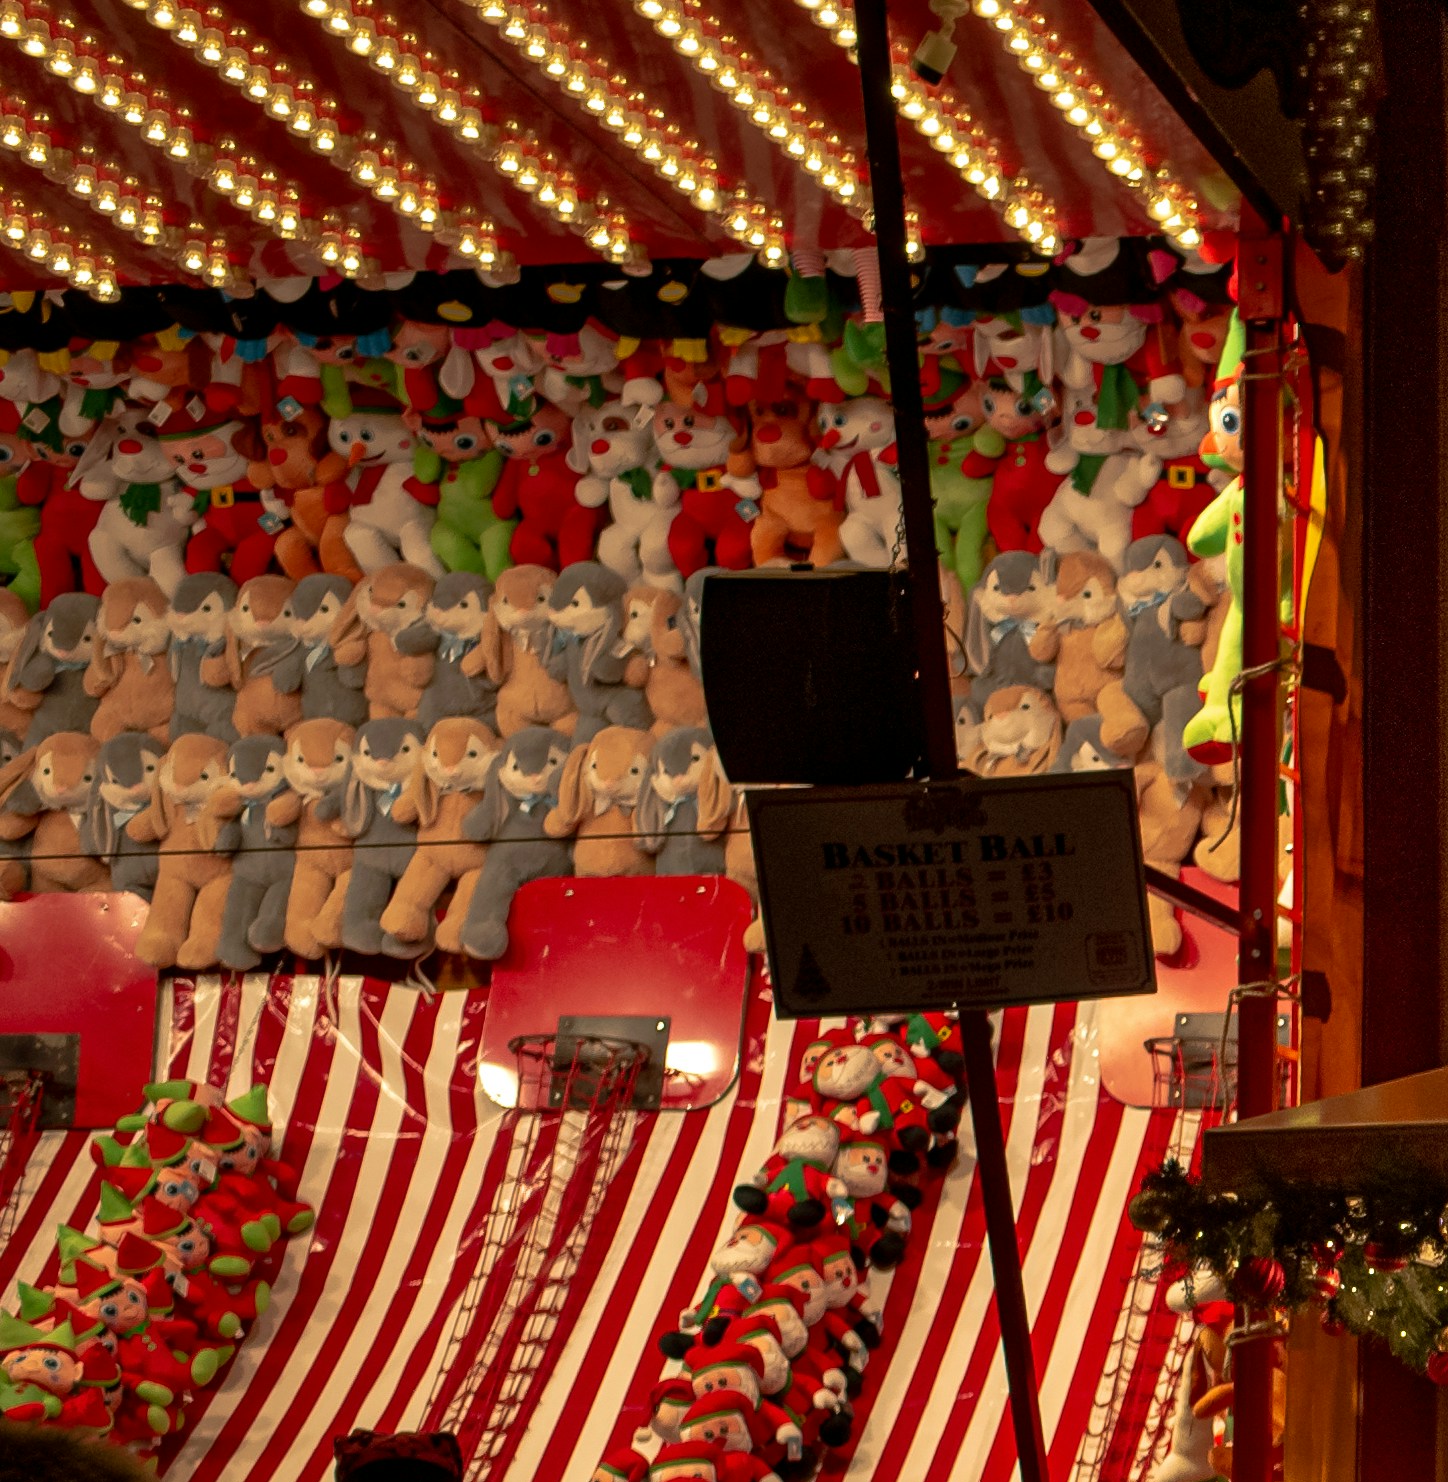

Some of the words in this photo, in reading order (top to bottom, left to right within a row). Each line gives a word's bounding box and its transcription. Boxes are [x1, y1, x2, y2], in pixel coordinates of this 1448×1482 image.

[875, 868, 973, 890] BALLS
[1022, 861, 1053, 882] £3
[853, 893, 867, 913] 5
[880, 888, 976, 911] BALLS
[1025, 882, 1055, 903] £5
[842, 915, 871, 934] 10
[883, 909, 980, 932] BALLS
[1027, 902, 1073, 924] £10
[1004, 958, 1035, 970] Prize
